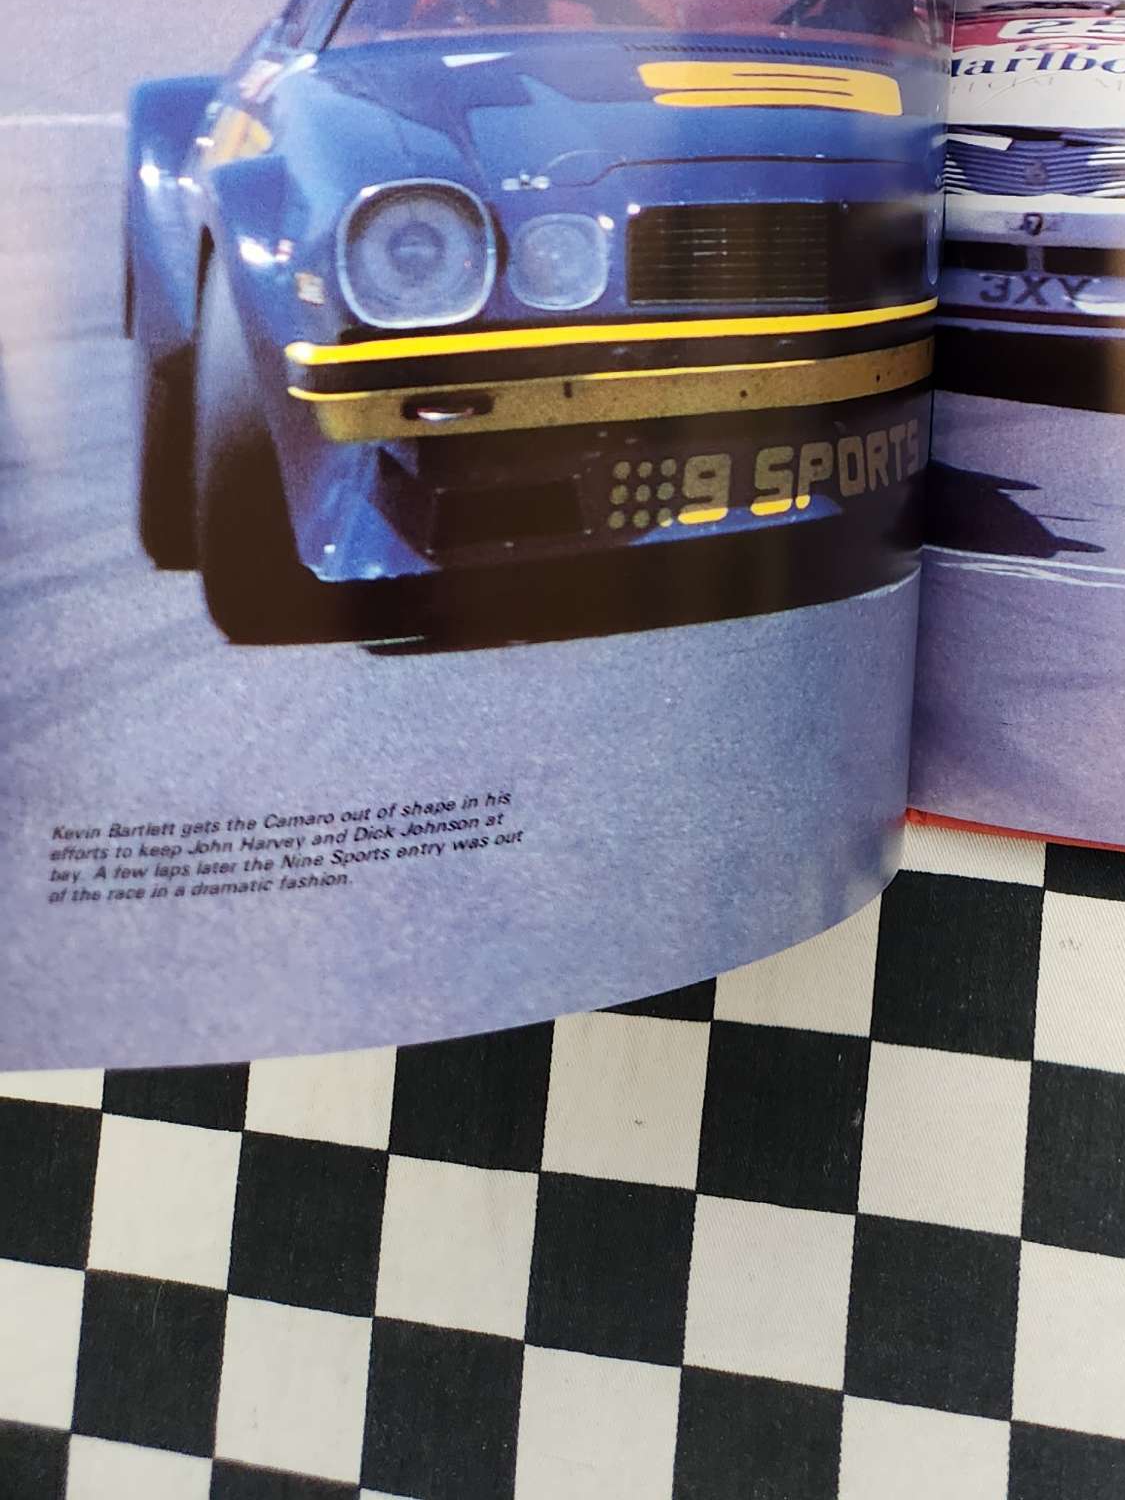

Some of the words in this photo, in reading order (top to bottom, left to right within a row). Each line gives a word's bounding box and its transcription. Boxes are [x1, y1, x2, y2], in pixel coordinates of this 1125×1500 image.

[750, 419, 919, 517] SPORTS
[49, 845, 109, 861] efforts
[115, 844, 133, 859] to
[138, 842, 182, 860] keep
[187, 838, 233, 855] John
[240, 834, 304, 852] Harvey
[311, 829, 348, 846] and
[354, 825, 394, 843] Dick
[399, 815, 480, 837] Johnson
[485, 812, 505, 827] at
[52, 825, 100, 840] Kevin
[109, 822, 176, 838] Bartlett
[181, 820, 220, 838] gets
[226, 816, 257, 831] the
[264, 812, 334, 829] Camaro
[341, 808, 371, 823] out
[377, 802, 398, 819] of
[401, 798, 456, 817] shape
[461, 795, 479, 810] in
[485, 790, 511, 806] his
[93, 866, 107, 880] A
[112, 864, 148, 880] few
[154, 863, 190, 881] laps
[196, 859, 237, 876] later
[243, 856, 274, 872] the
[281, 852, 323, 869] Nine
[331, 845, 391, 866] Sports
[396, 841, 445, 859] entry
[452, 835, 489, 851] was
[494, 830, 524, 846] out
[48, 888, 66, 905] of
[71, 886, 100, 902] the
[107, 886, 146, 901] race
[151, 883, 168, 899] in
[174, 886, 186, 898] a
[191, 878, 273, 897] dramatic
